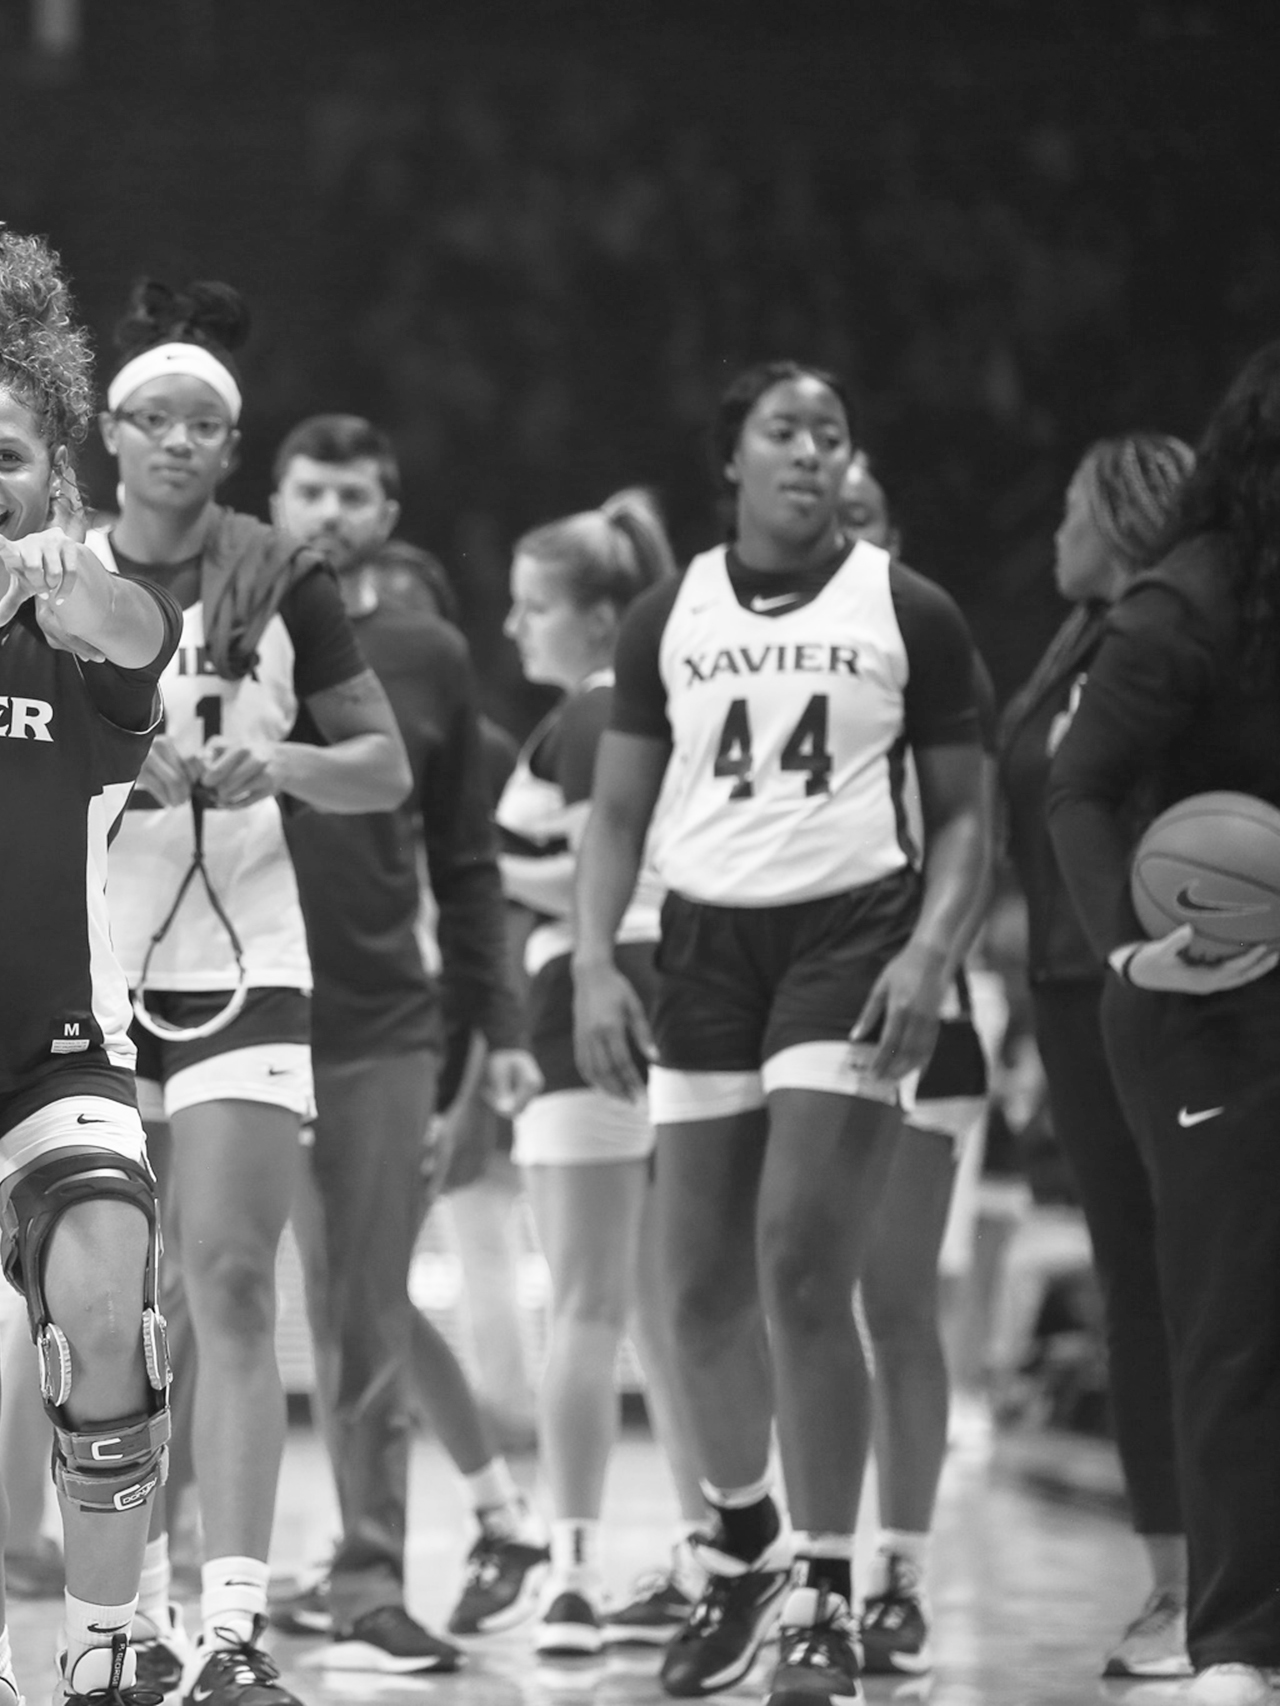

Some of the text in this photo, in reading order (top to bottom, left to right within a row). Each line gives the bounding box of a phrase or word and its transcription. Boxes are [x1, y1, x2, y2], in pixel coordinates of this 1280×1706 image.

[683, 643, 862, 690] XAVIER
[714, 693, 833, 799] 44
[64, 1023, 80, 1036] M
